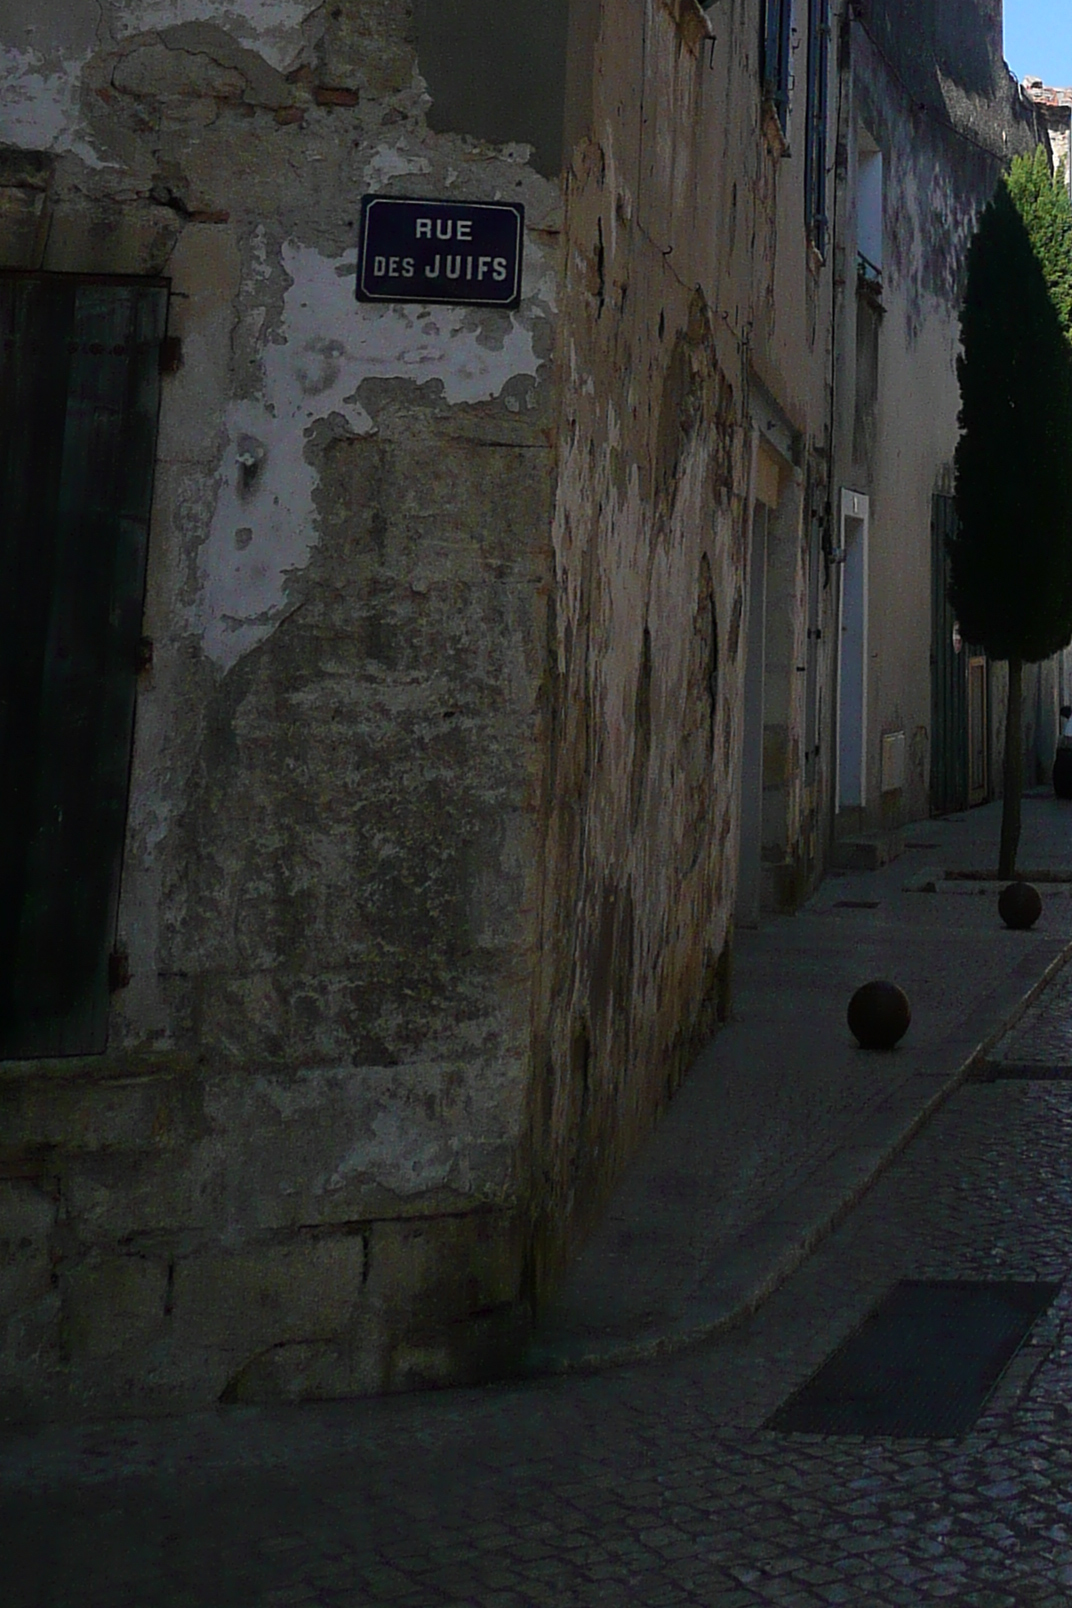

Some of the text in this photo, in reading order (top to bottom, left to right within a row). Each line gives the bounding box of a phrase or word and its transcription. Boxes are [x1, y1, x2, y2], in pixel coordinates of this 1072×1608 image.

[415, 218, 473, 241] RUE
[373, 254, 507, 281] DES JUIFS
